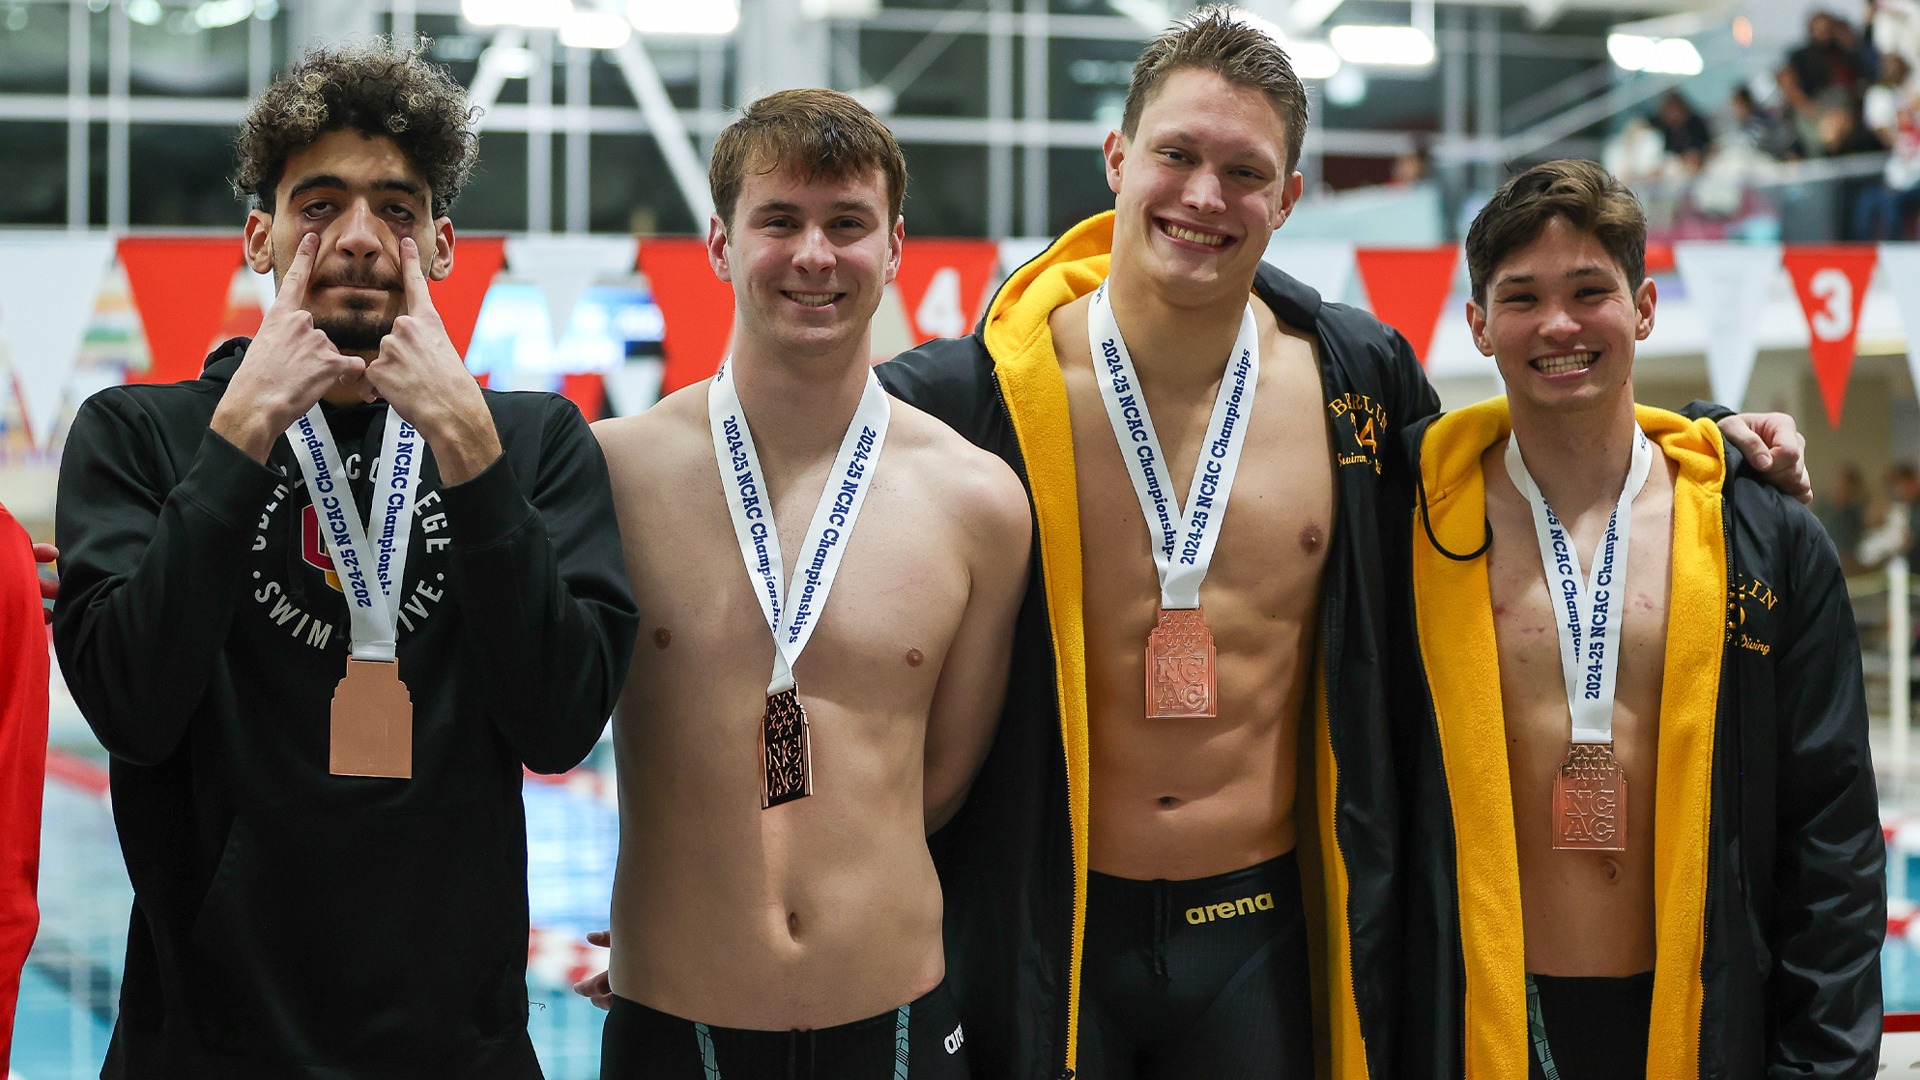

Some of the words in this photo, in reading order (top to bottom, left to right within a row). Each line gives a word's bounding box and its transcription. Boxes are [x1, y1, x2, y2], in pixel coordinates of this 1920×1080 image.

[916, 267, 966, 338] 4
[1811, 268, 1853, 342] 3
[298, 414, 334, 493] Champion
[391, 442, 414, 489] NCAC
[723, 415, 749, 472] 2024-25
[736, 471, 764, 520] NCAC
[846, 425, 877, 480] 2024-25
[1101, 338, 1131, 394] 2024-25
[1119, 393, 1149, 442] NCAC
[1136, 445, 1177, 562] Championship
[1180, 511, 1209, 565] 2024-25
[1196, 460, 1222, 509] NCAC
[1211, 348, 1252, 459] Championships
[322, 496, 352, 547] NCAC
[829, 480, 859, 527] NCAC
[377, 493, 405, 595] Championsh
[1550, 528, 1573, 575] NCAC
[340, 549, 372, 608] 2024-25
[789, 528, 840, 643] Championships
[255, 581, 333, 650] SWIM
[395, 579, 444, 640] IVE
[1590, 590, 1610, 638] NCAC
[1157, 655, 1206, 684] NC
[1584, 641, 1605, 700] 2024-25
[1157, 682, 1207, 711] AC
[767, 735, 802, 769] NC
[769, 761, 804, 797] AC
[1565, 789, 1616, 816] NC
[1564, 815, 1616, 842] AC
[1185, 892, 1275, 925] arena
